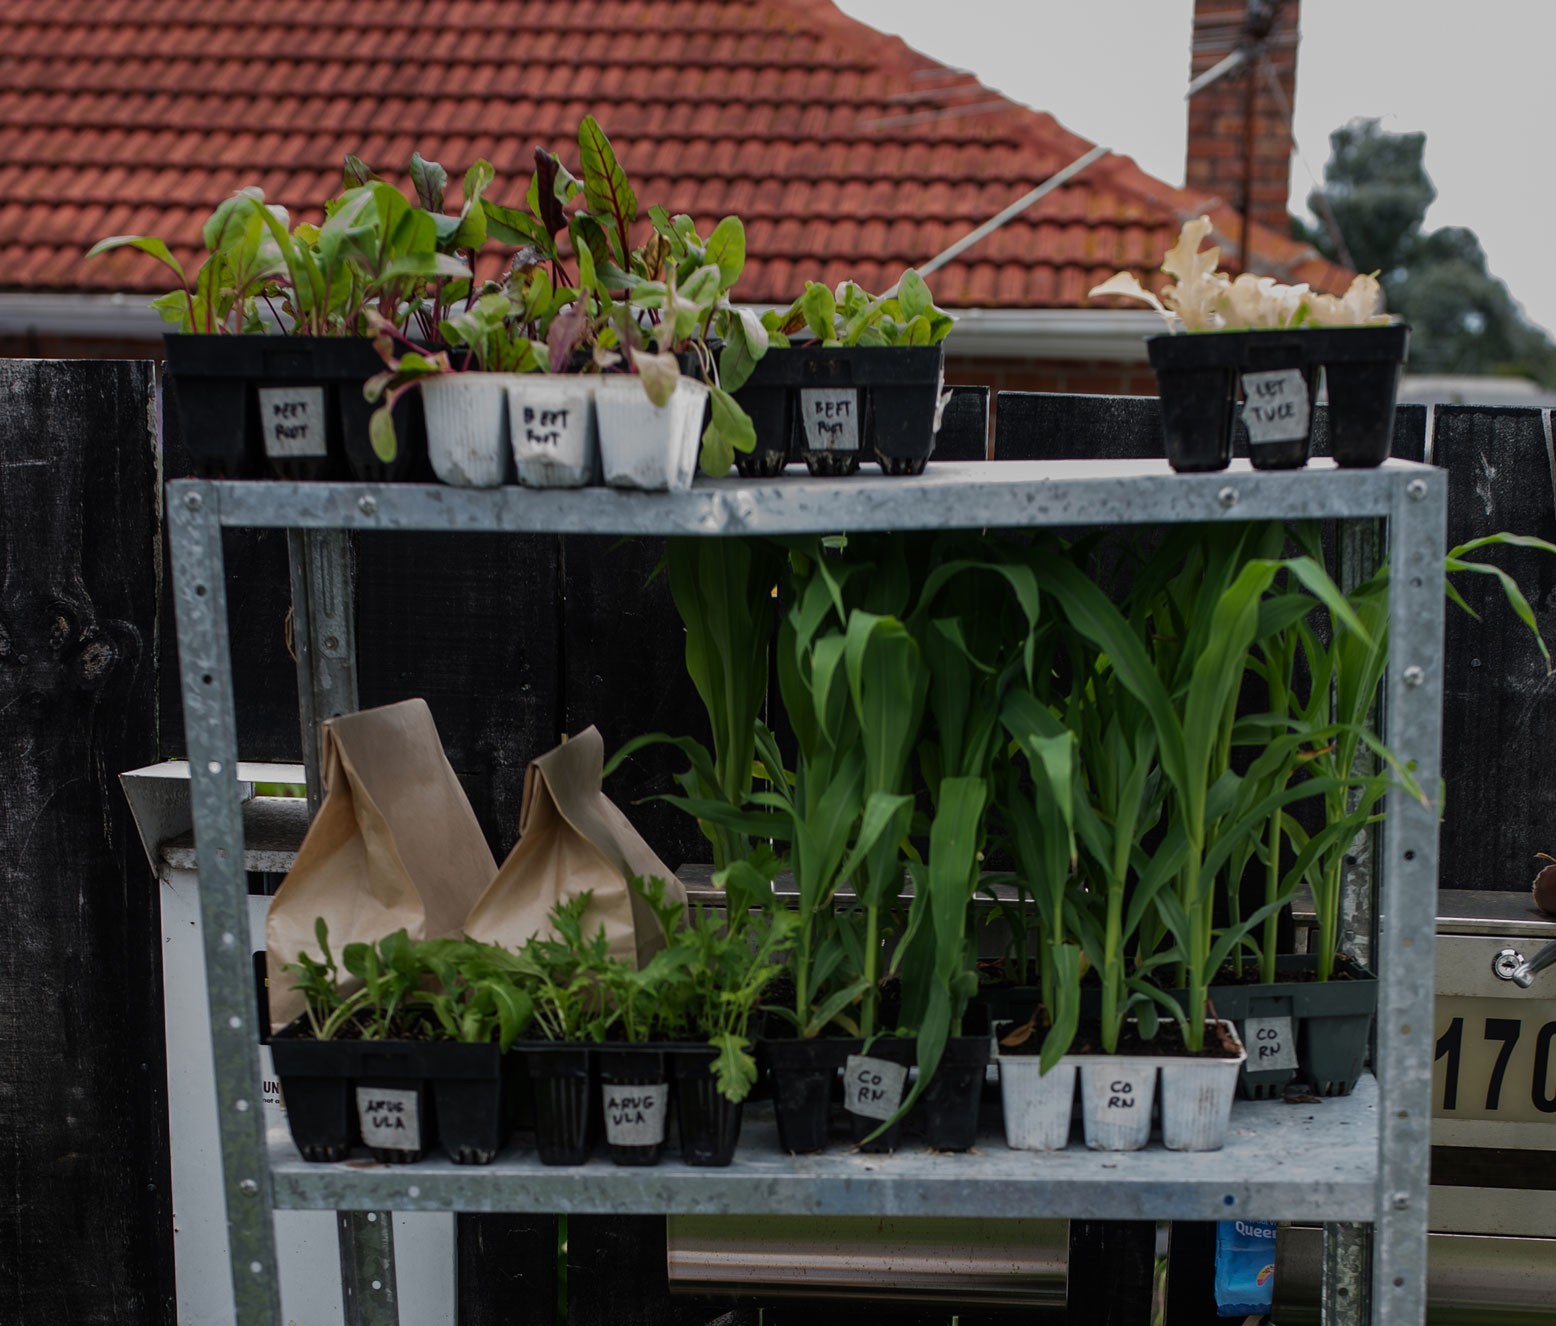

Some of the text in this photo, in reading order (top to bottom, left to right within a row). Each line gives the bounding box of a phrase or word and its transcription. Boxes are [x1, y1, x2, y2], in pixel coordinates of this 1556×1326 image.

[1256, 379, 1286, 397] LET
[815, 401, 851, 418] BEET
[1257, 1028, 1277, 1040] CO
[1259, 1043, 1280, 1060] RN
[858, 1070, 882, 1085] CO
[858, 1087, 884, 1101] RN
[1110, 1081, 1132, 1093] CO
[608, 1096, 655, 1110] ARUG
[1108, 1096, 1134, 1108] RN
[373, 1116, 406, 1130] ULA
[613, 1111, 645, 1126] ULA
